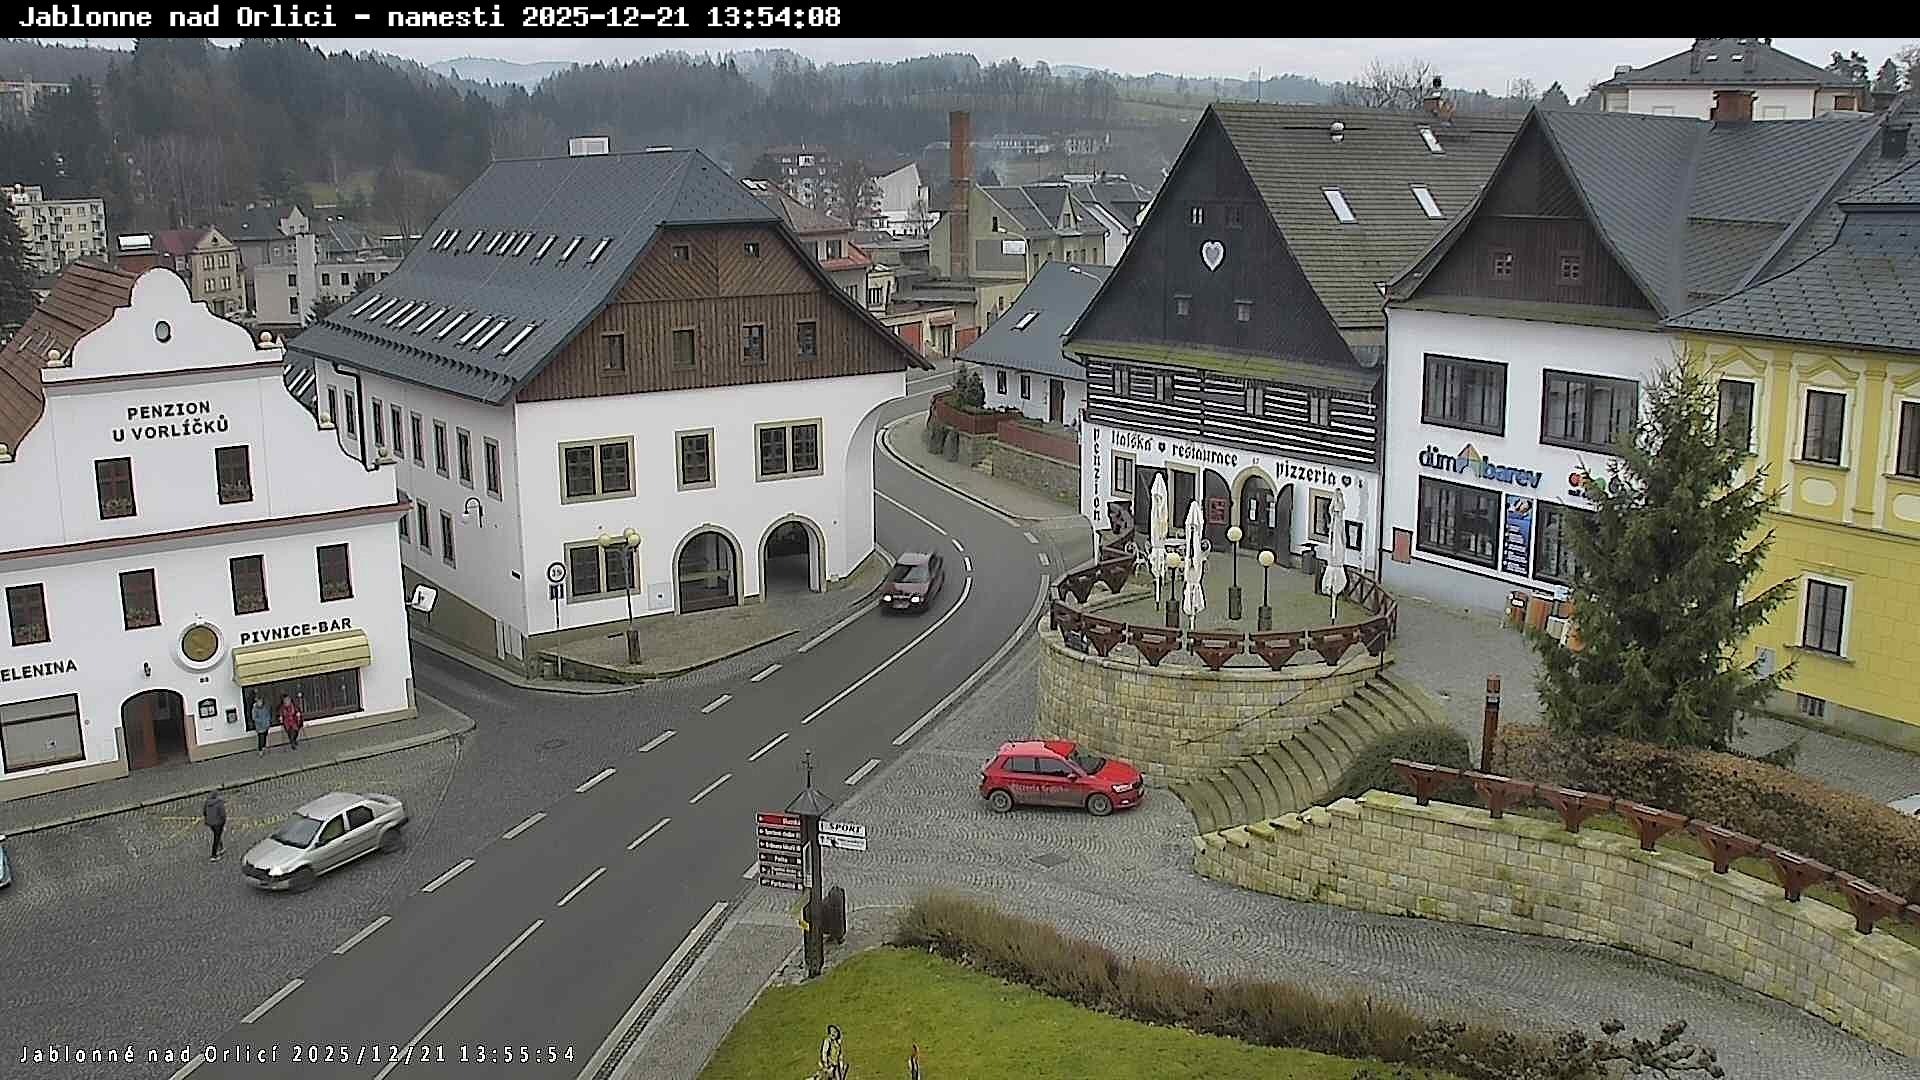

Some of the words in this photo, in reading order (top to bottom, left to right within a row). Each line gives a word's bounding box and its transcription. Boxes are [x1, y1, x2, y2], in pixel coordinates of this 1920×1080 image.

[127, 400, 210, 420] PENZION
[112, 429, 125, 442] U
[131, 414, 229, 440] VORLÍČKŮ
[1276, 460, 1336, 486] pizzeria
[1482, 455, 1543, 488] barev
[240, 617, 352, 645] PIVNICE-BAR
[0, 659, 78, 682] ELENINA
[829, 822, 862, 833] SPORT
